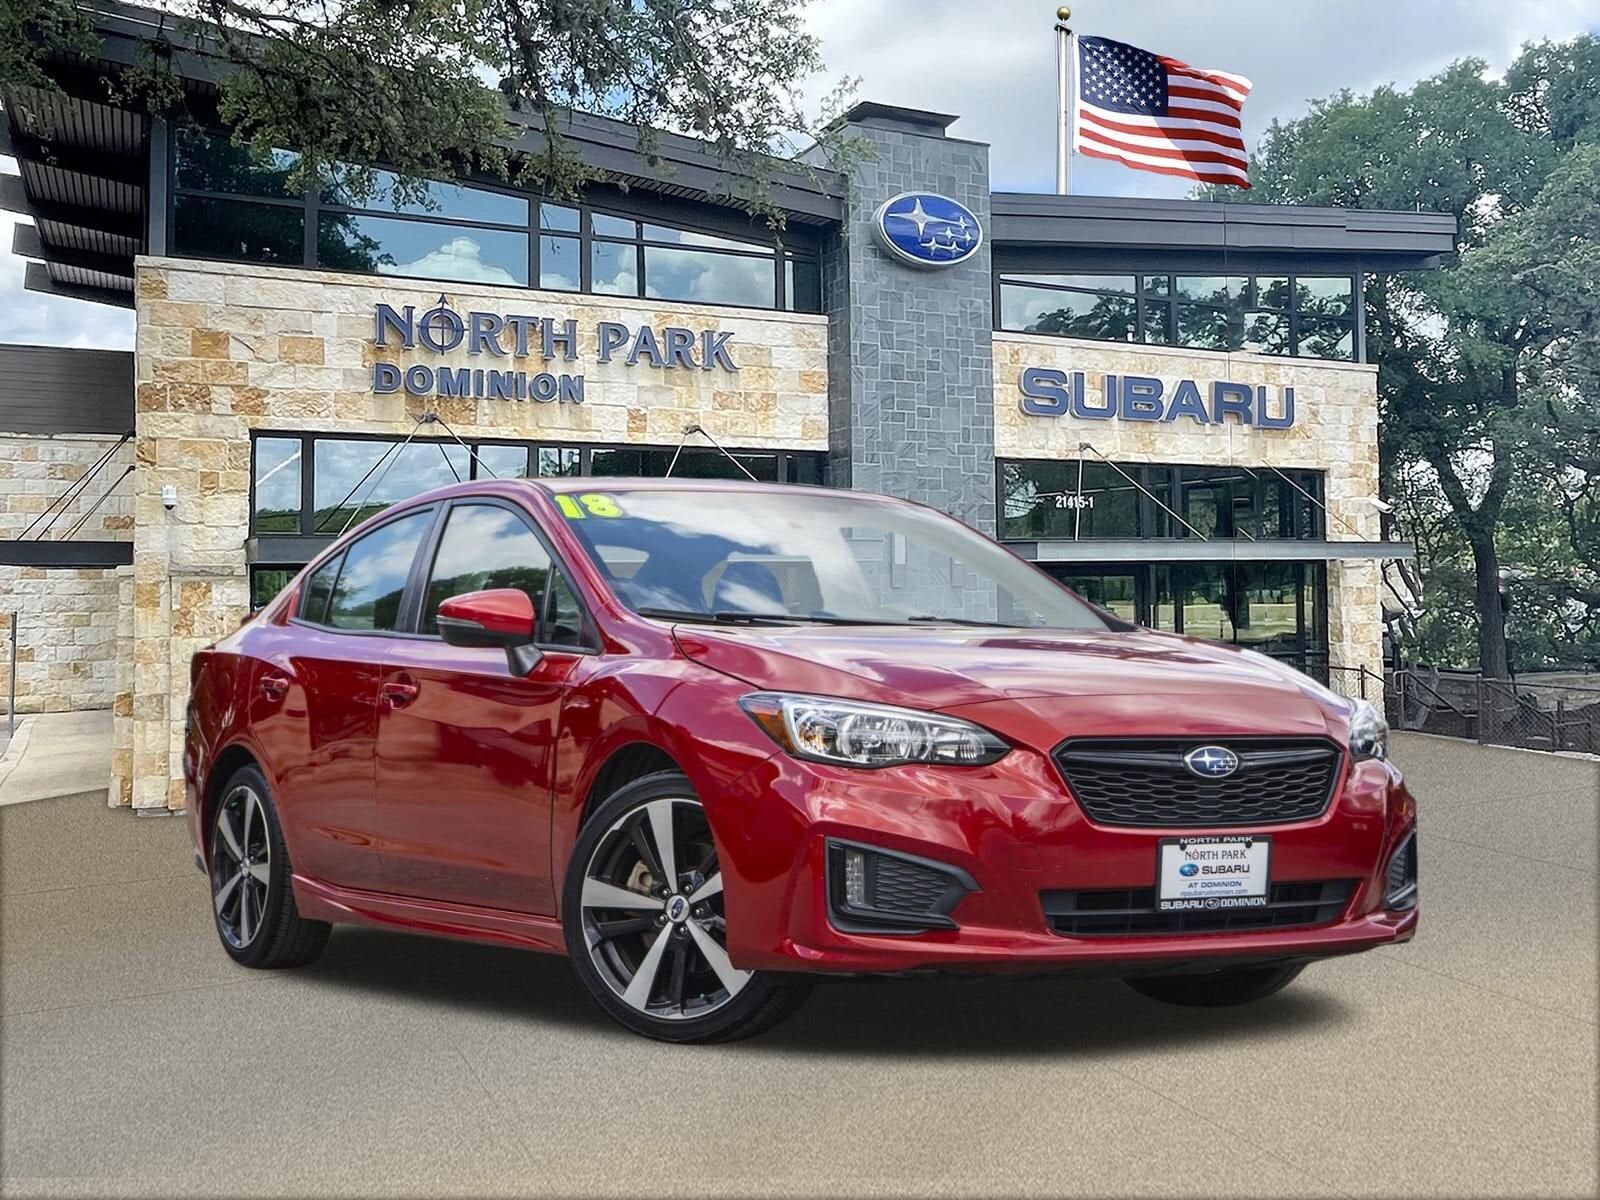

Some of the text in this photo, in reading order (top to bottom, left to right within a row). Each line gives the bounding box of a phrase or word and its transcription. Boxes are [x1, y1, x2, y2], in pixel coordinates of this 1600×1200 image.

[374, 299, 739, 372] NORTH PARK
[372, 362, 585, 404] DOMINION
[1018, 366, 1296, 430] SUBARU
[554, 493, 624, 519] 18
[1185, 849, 1247, 860] NORTH PARK
[1201, 864, 1250, 875] SUBARU
[1200, 880, 1242, 889] DOMINION
[1160, 897, 1266, 910] SUBARU DOMINION
